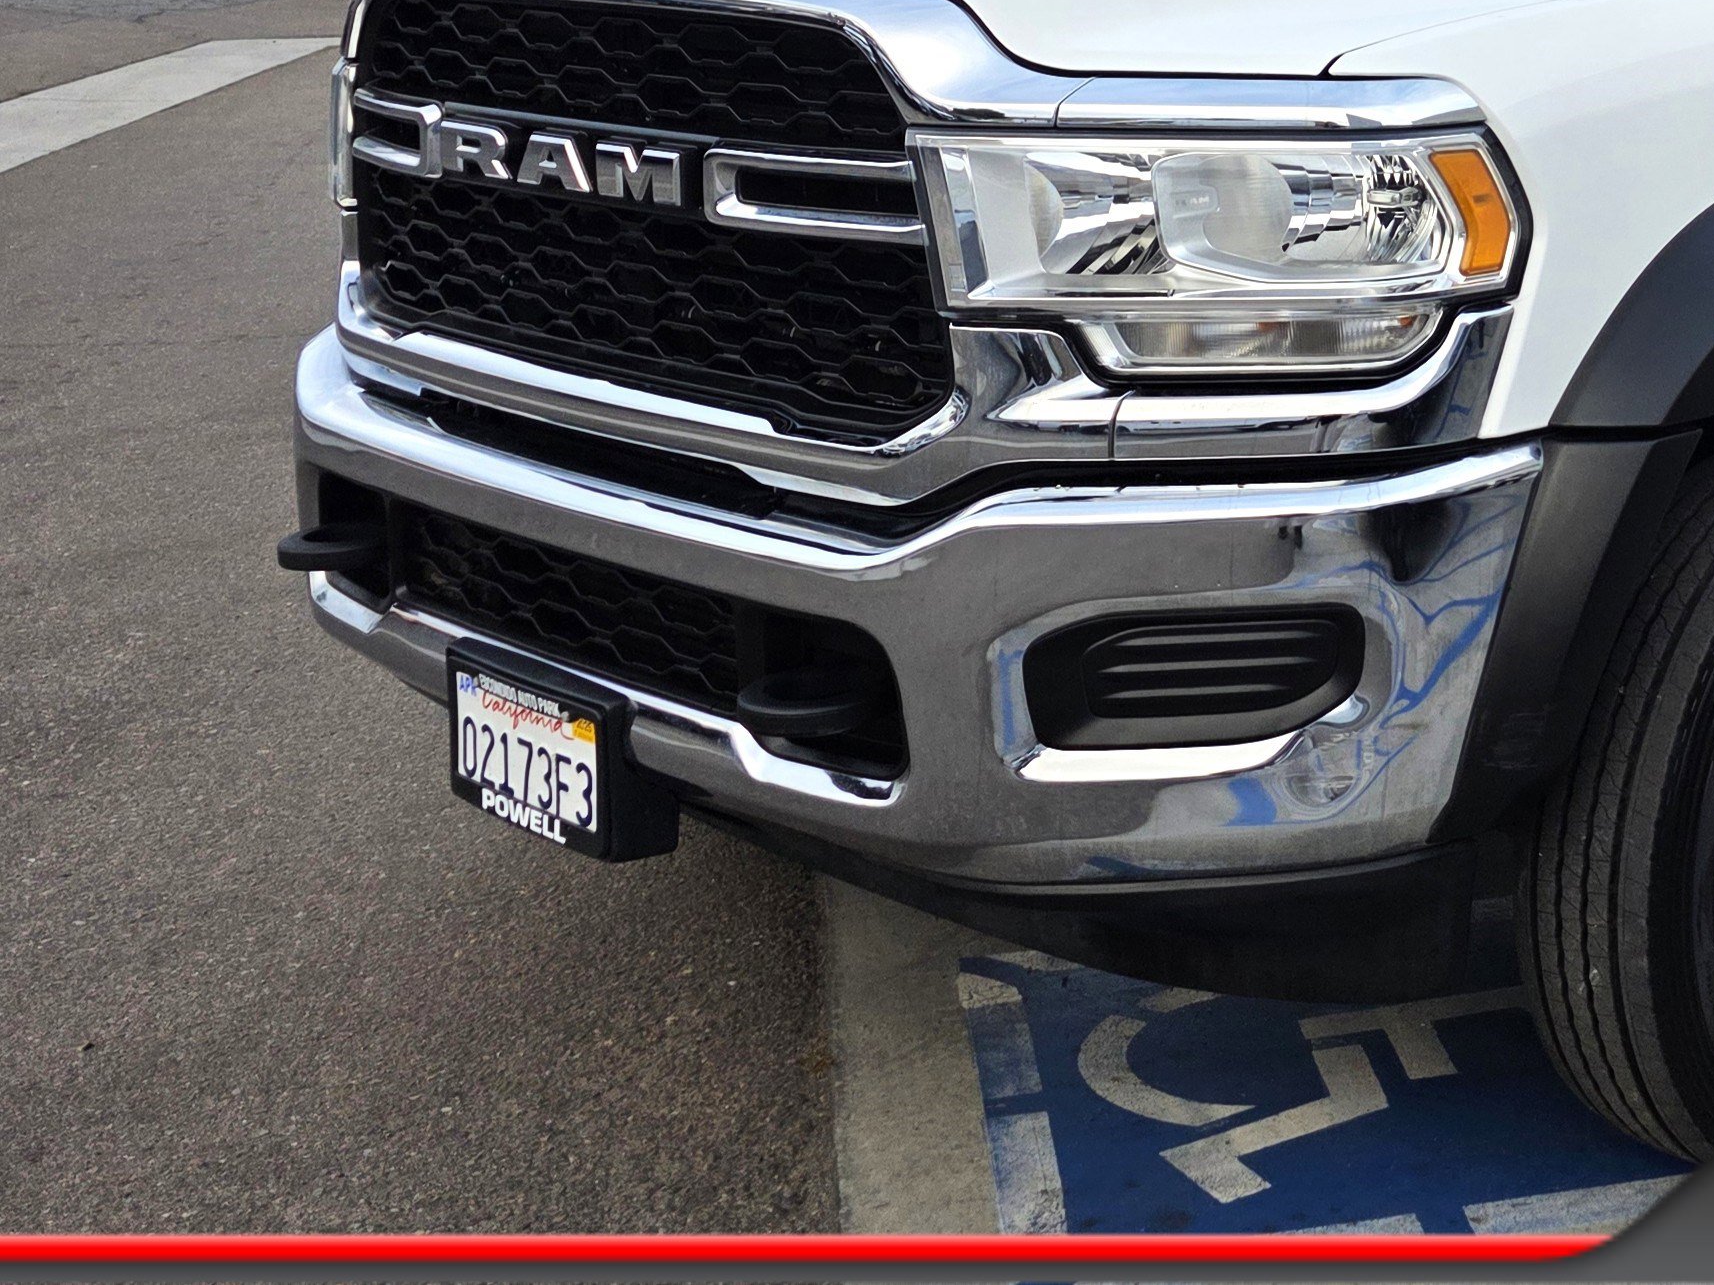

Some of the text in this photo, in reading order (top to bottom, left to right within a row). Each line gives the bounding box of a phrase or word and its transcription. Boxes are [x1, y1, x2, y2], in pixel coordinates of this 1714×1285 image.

[440, 119, 682, 207] RAM
[482, 689, 574, 740] California
[462, 715, 593, 828] 02173F3
[481, 787, 567, 845] POWELL
